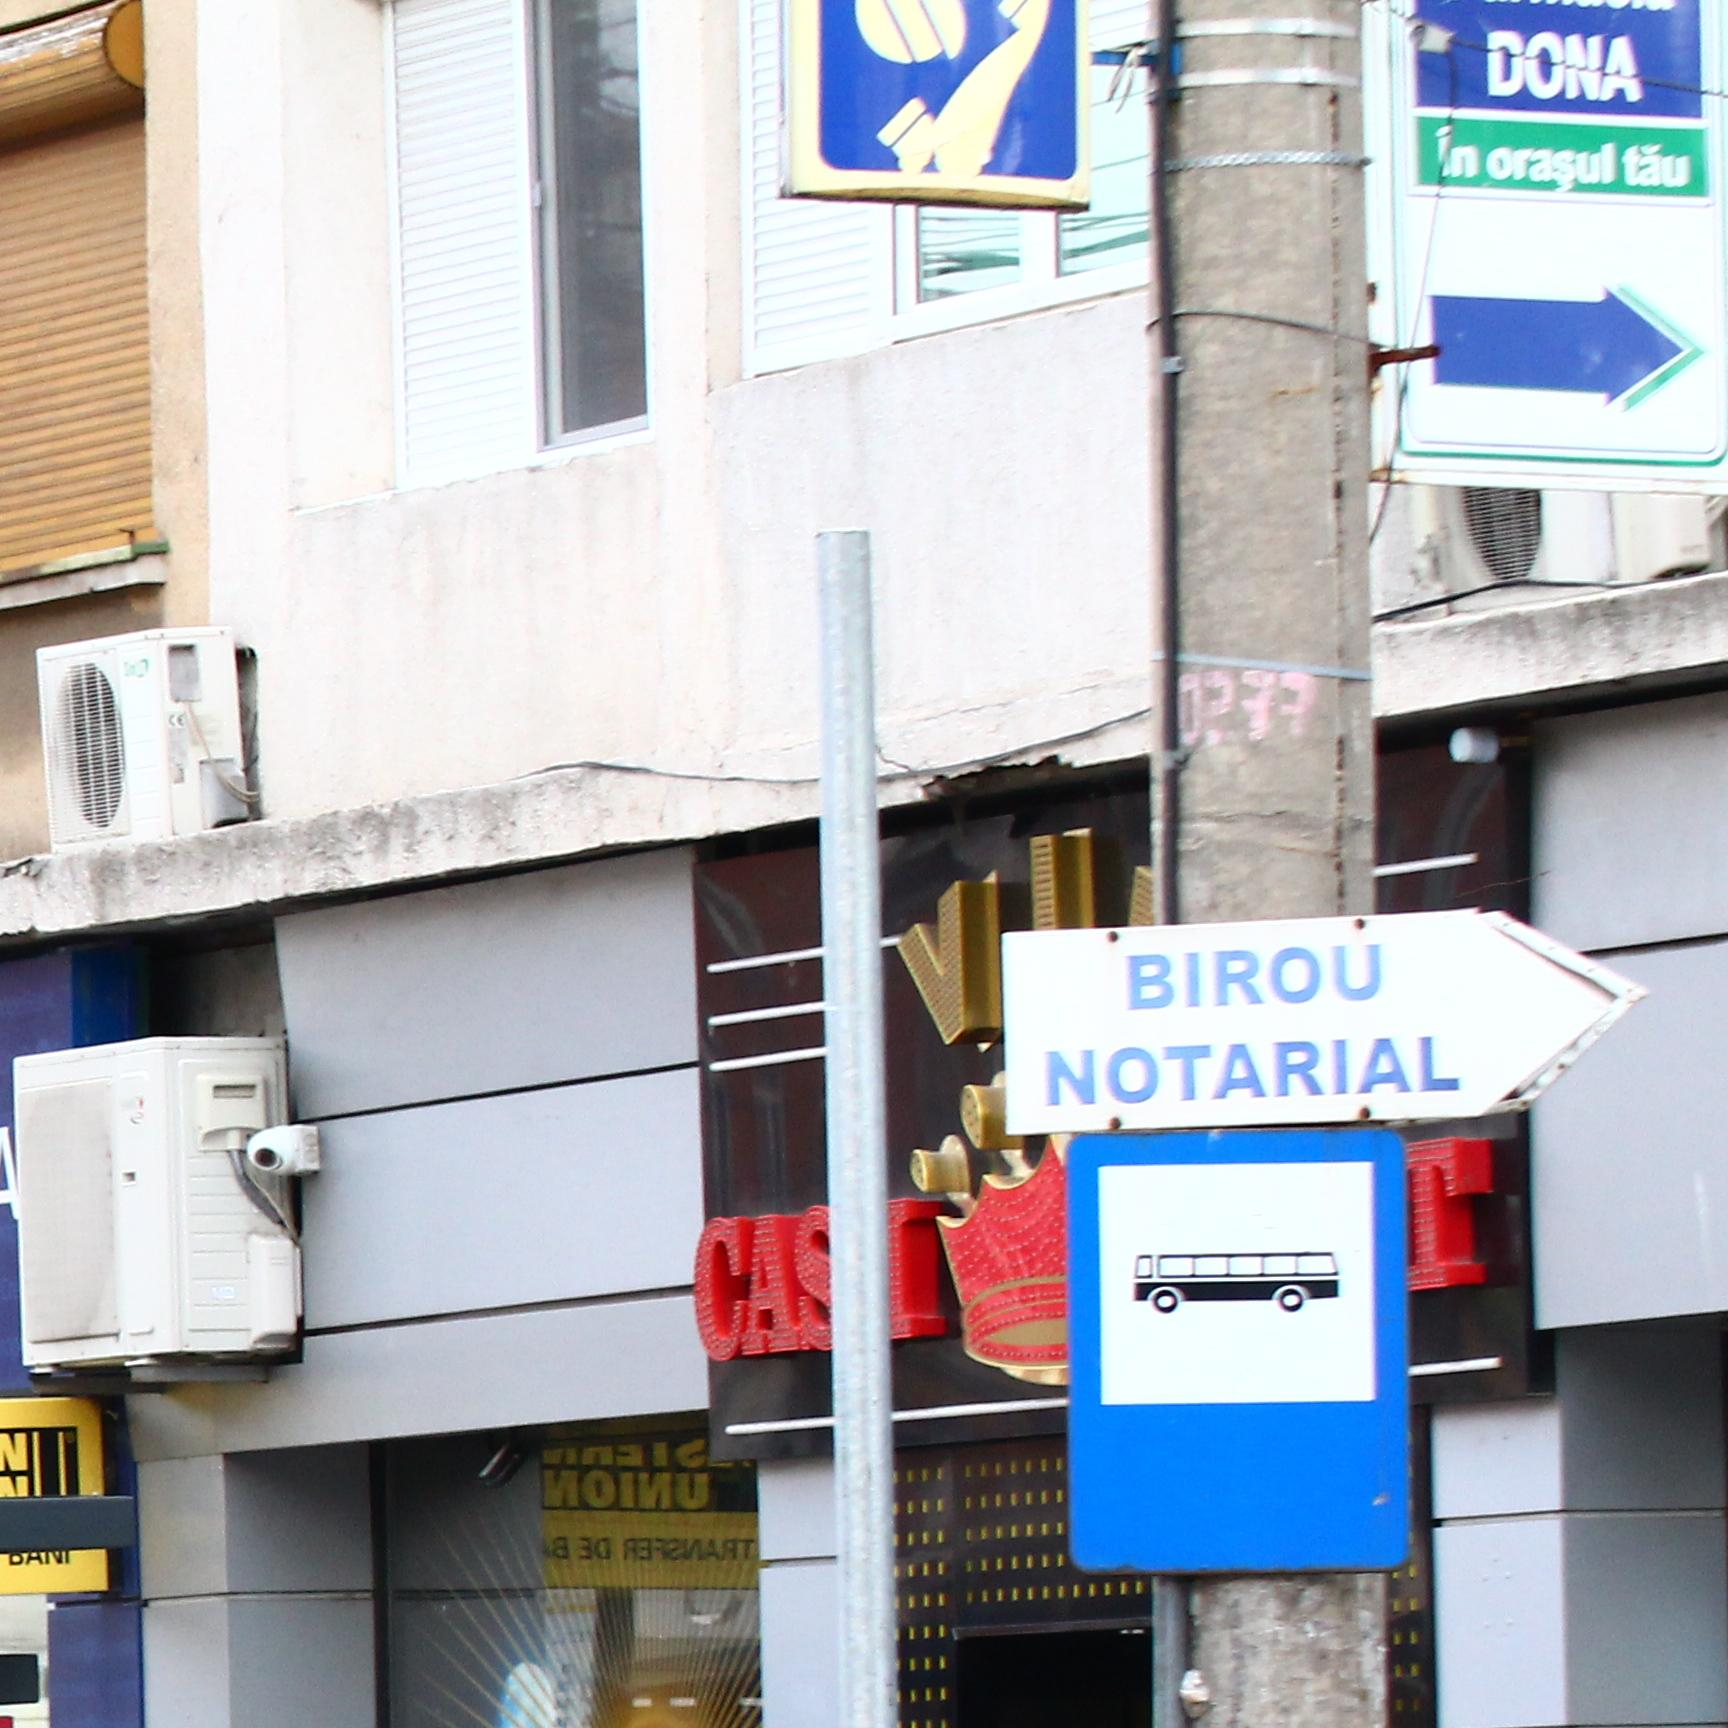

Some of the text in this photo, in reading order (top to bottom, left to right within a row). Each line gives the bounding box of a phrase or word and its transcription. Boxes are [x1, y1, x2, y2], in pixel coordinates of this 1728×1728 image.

[1486, 30, 1643, 102] DONA
[1623, 143, 1691, 187] tău
[1126, 943, 1382, 1011] BIROU
[1045, 1036, 1460, 1107] NOTARIAL
